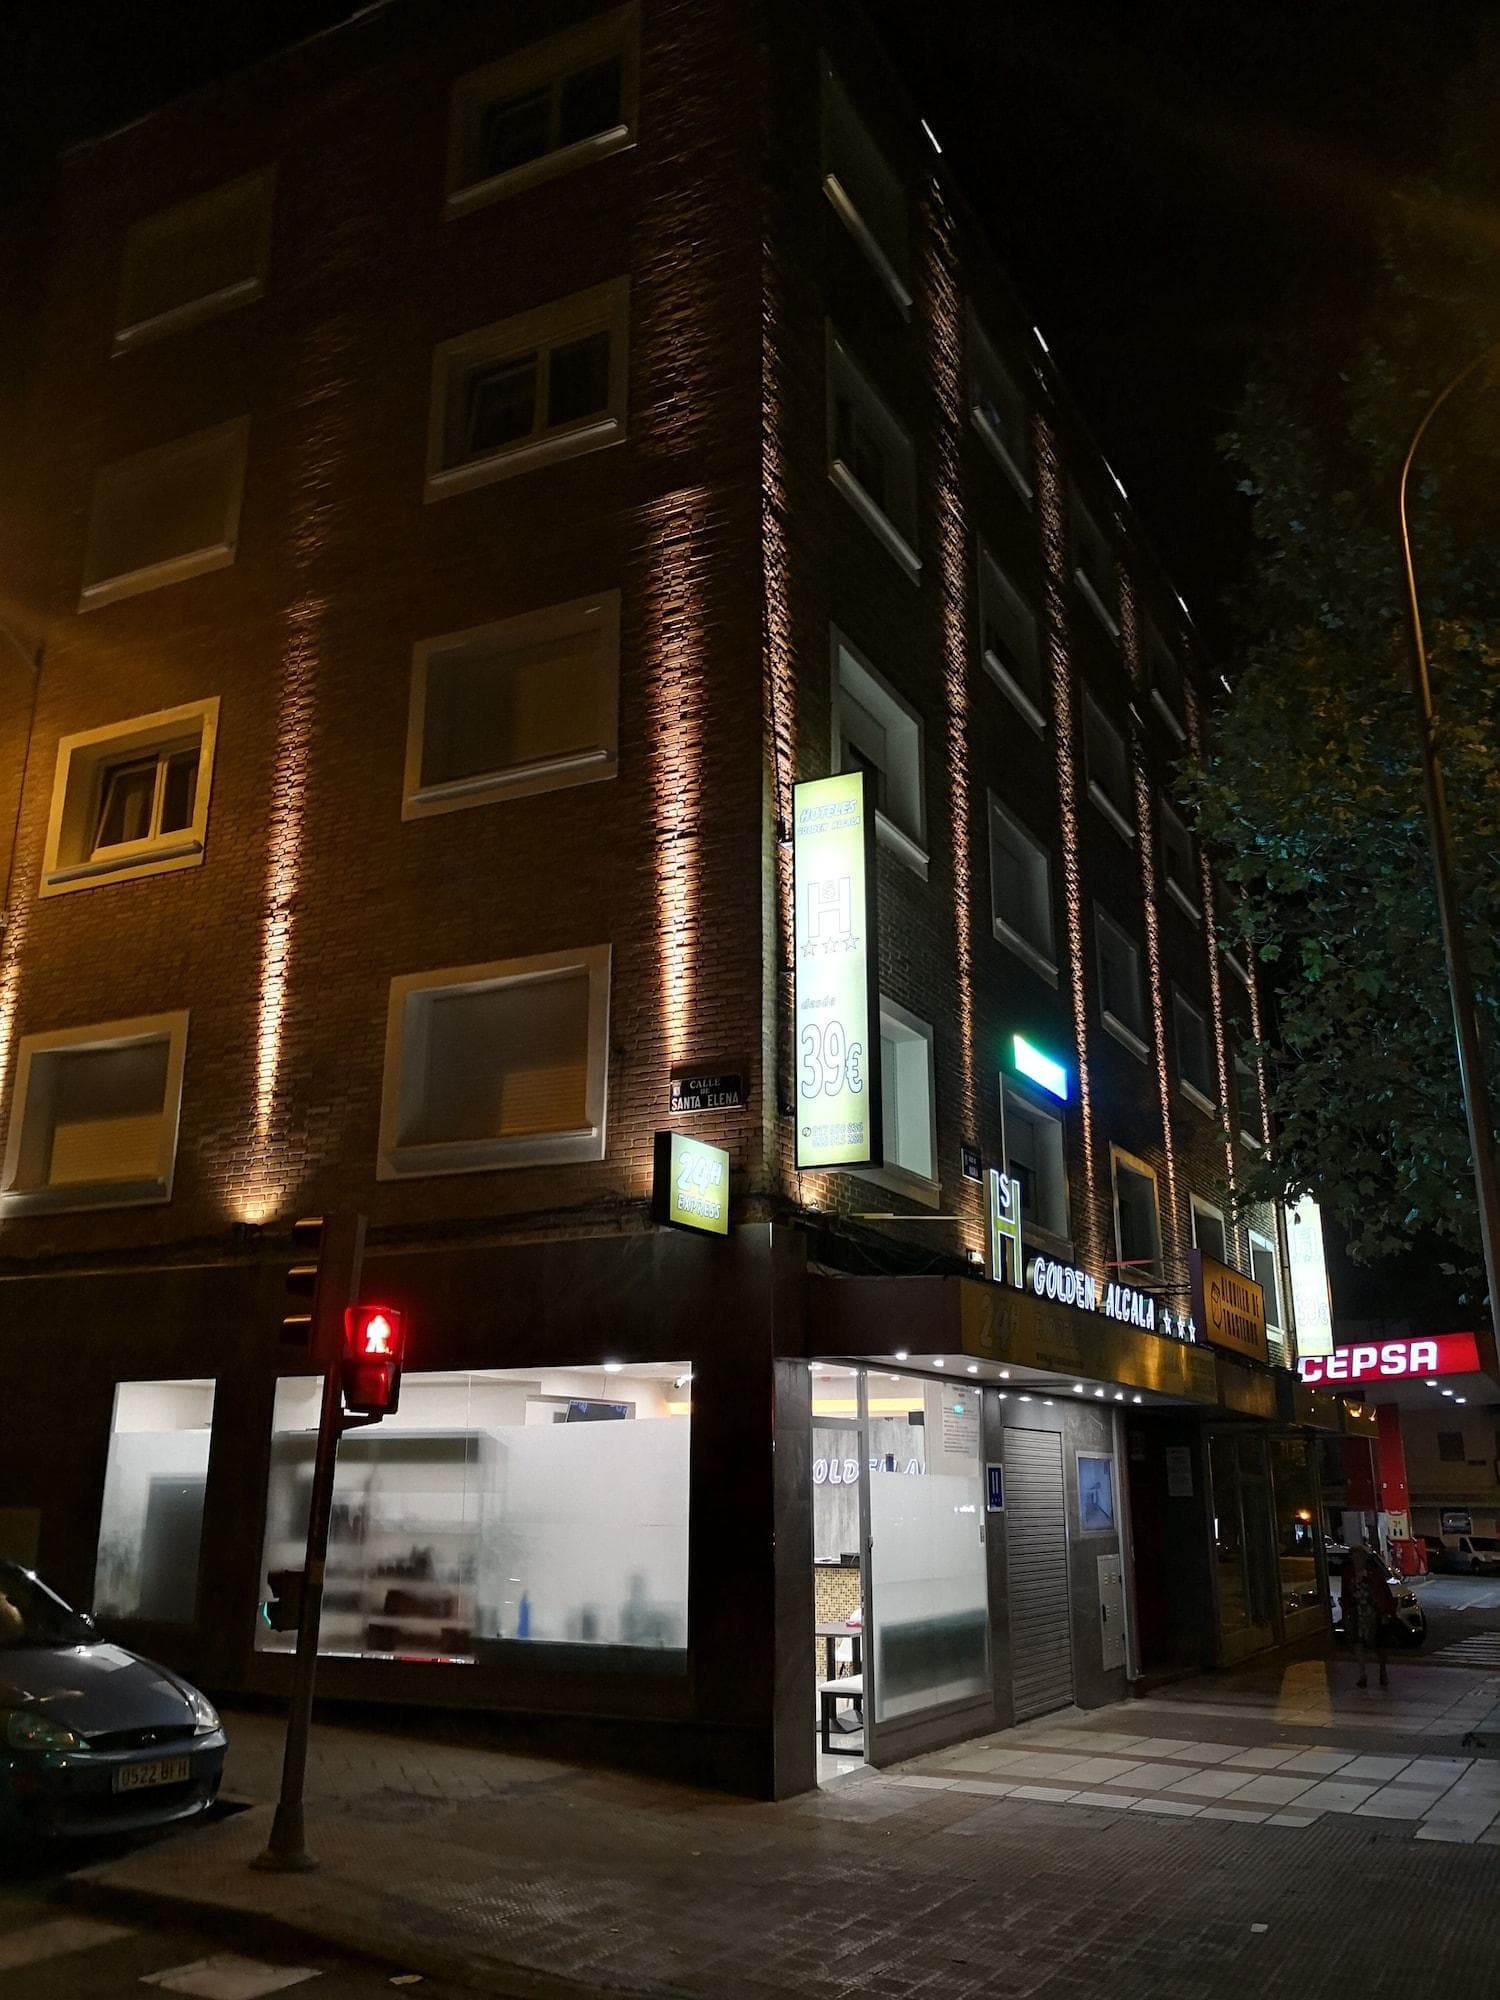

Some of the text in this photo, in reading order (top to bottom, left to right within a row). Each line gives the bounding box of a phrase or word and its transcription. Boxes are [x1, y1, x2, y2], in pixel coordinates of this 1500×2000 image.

[800, 799, 858, 823] HOTELES
[801, 1020, 864, 1099] 39€
[689, 1078, 721, 1090] CALLE
[671, 1092, 740, 1111] SANTA ELENA
[678, 1193, 722, 1220] EXPRESS
[1033, 1257, 1096, 1312] GOLDEN
[1105, 1283, 1155, 1331] ALCALA
[1297, 1341, 1438, 1383] CEPSA
[122, 1762, 158, 1786] 0522
